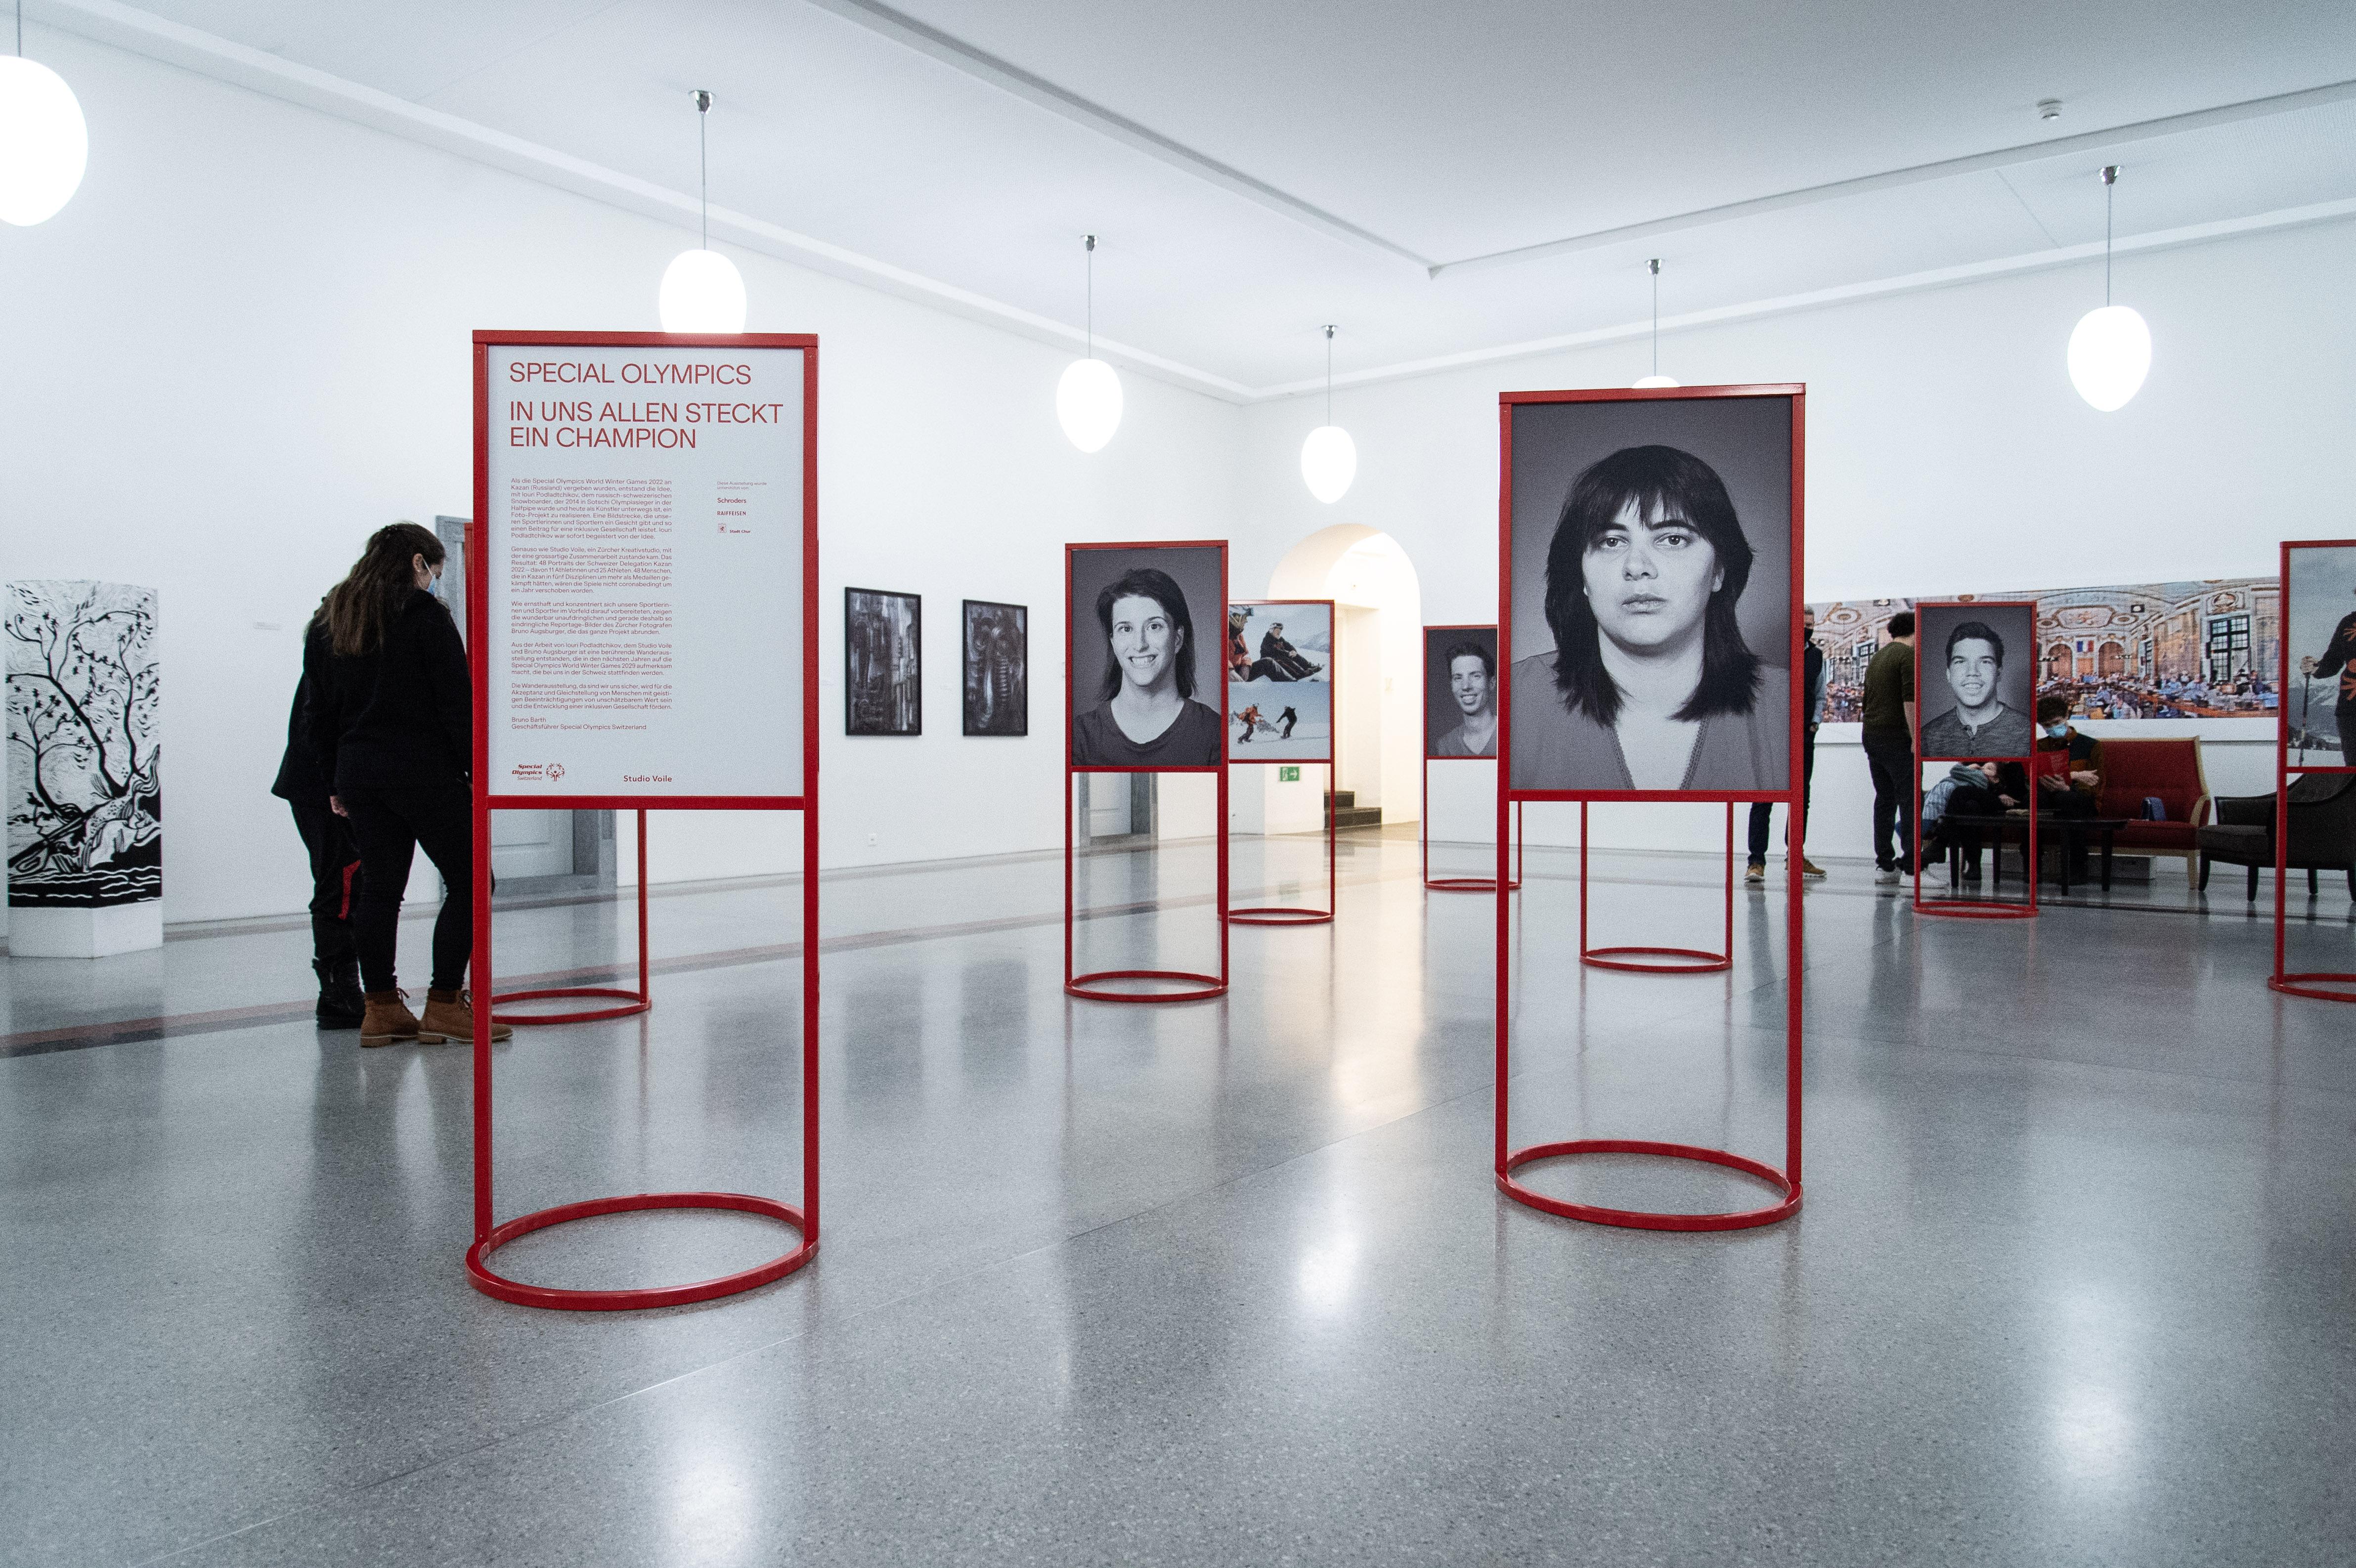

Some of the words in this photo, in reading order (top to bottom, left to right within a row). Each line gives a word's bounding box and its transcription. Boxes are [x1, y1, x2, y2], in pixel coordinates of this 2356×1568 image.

[510, 362, 614, 383] SPECIAL
[621, 363, 751, 385] OLYMPICS
[511, 401, 532, 421] IN
[542, 402, 592, 422] UNS
[599, 402, 677, 422] ALLEN
[686, 403, 783, 423] STECKT
[511, 427, 548, 447] EIN
[557, 427, 695, 448] CHAMPION
